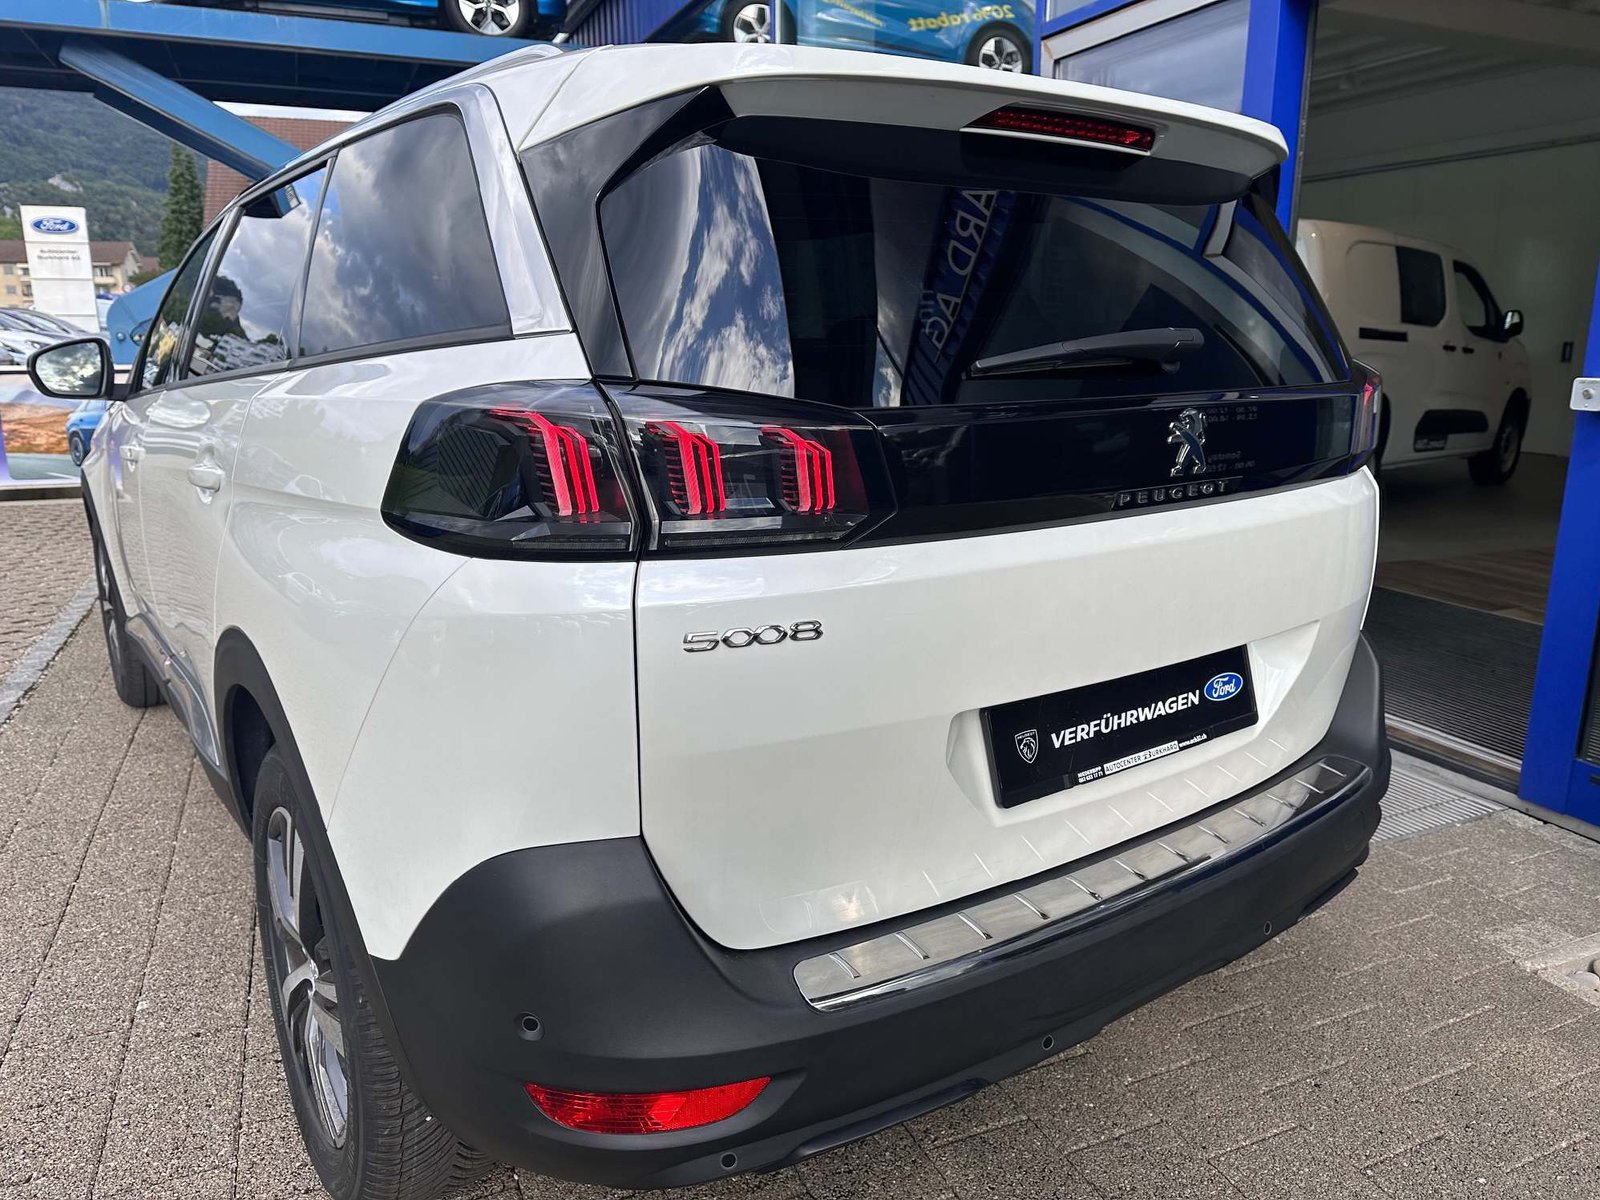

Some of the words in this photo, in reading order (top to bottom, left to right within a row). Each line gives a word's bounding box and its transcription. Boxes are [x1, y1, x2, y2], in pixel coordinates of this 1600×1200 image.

[1118, 480, 1229, 507] PEUGEOT
[682, 619, 824, 653] 5008
[1212, 676, 1237, 699] Ford
[1050, 689, 1200, 749] VERFÜHRWAGEN
[1105, 756, 1141, 772] AUTOCENTER
